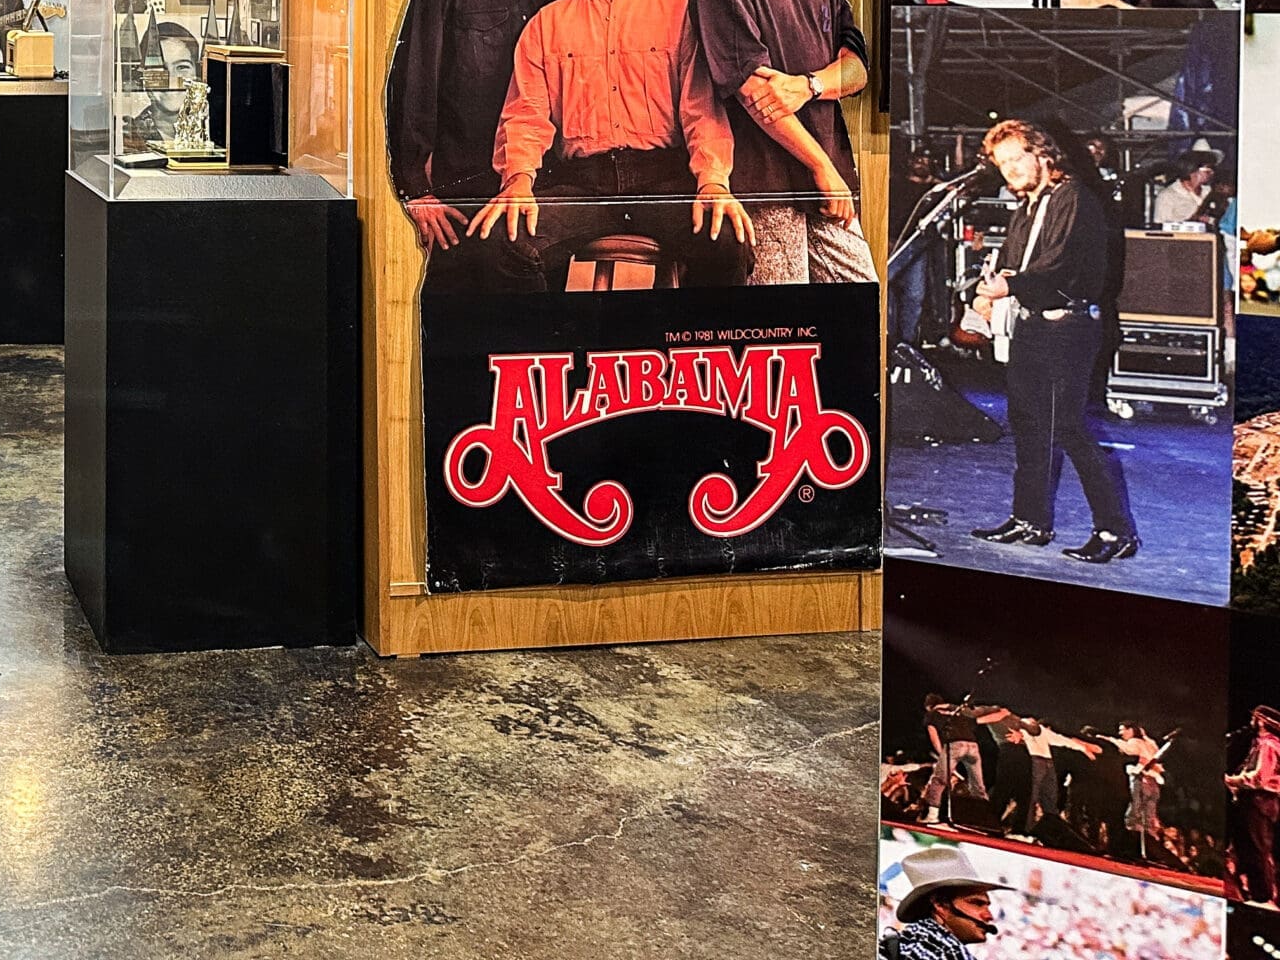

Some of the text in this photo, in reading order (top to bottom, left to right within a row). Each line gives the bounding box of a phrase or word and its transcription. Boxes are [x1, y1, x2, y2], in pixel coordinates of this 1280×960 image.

[694, 330, 713, 341] 1981
[717, 327, 793, 340] WILDCOUNTRY
[443, 343, 870, 547] ALABAMA
